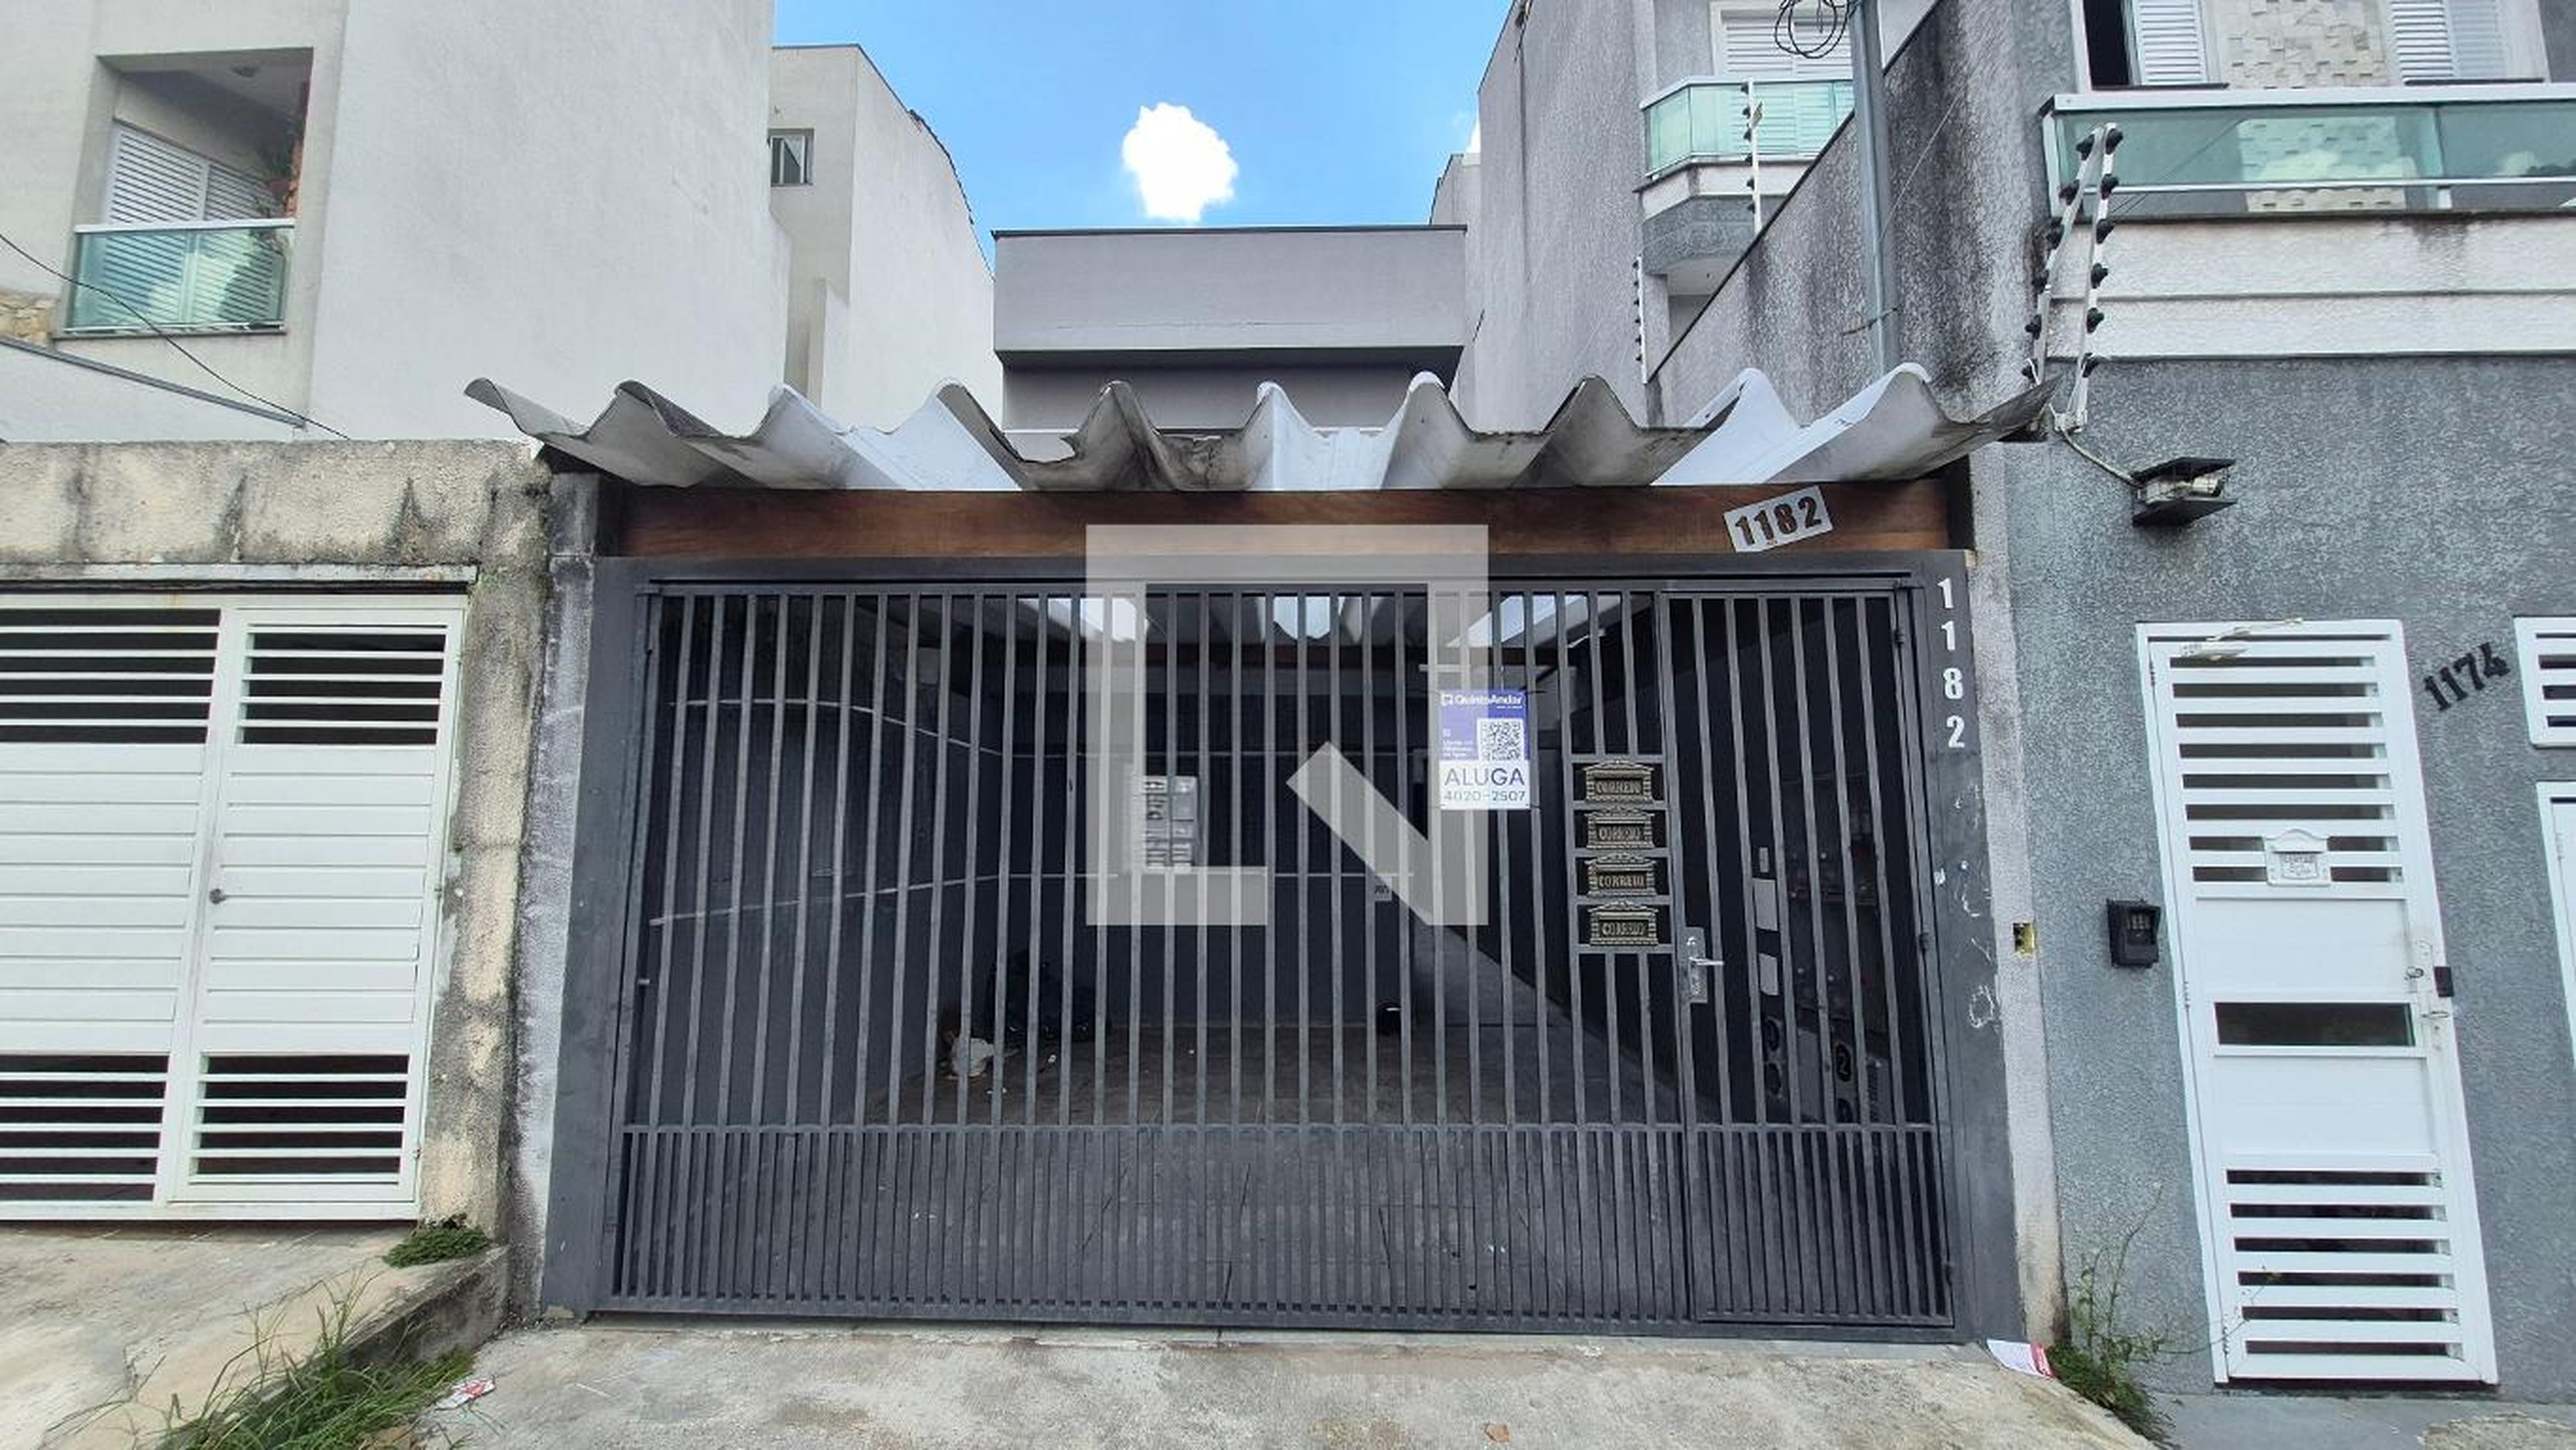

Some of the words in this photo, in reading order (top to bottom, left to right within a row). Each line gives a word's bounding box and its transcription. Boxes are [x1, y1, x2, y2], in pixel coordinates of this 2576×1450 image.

[1735, 496, 1822, 546] 1182
[1937, 577, 1966, 748] 1182
[2423, 642, 2510, 712] 1174
[1444, 768, 1525, 786] ALUGA
[1444, 791, 1525, 801] 4020-2507
[1599, 875, 1645, 888] CORREIO
